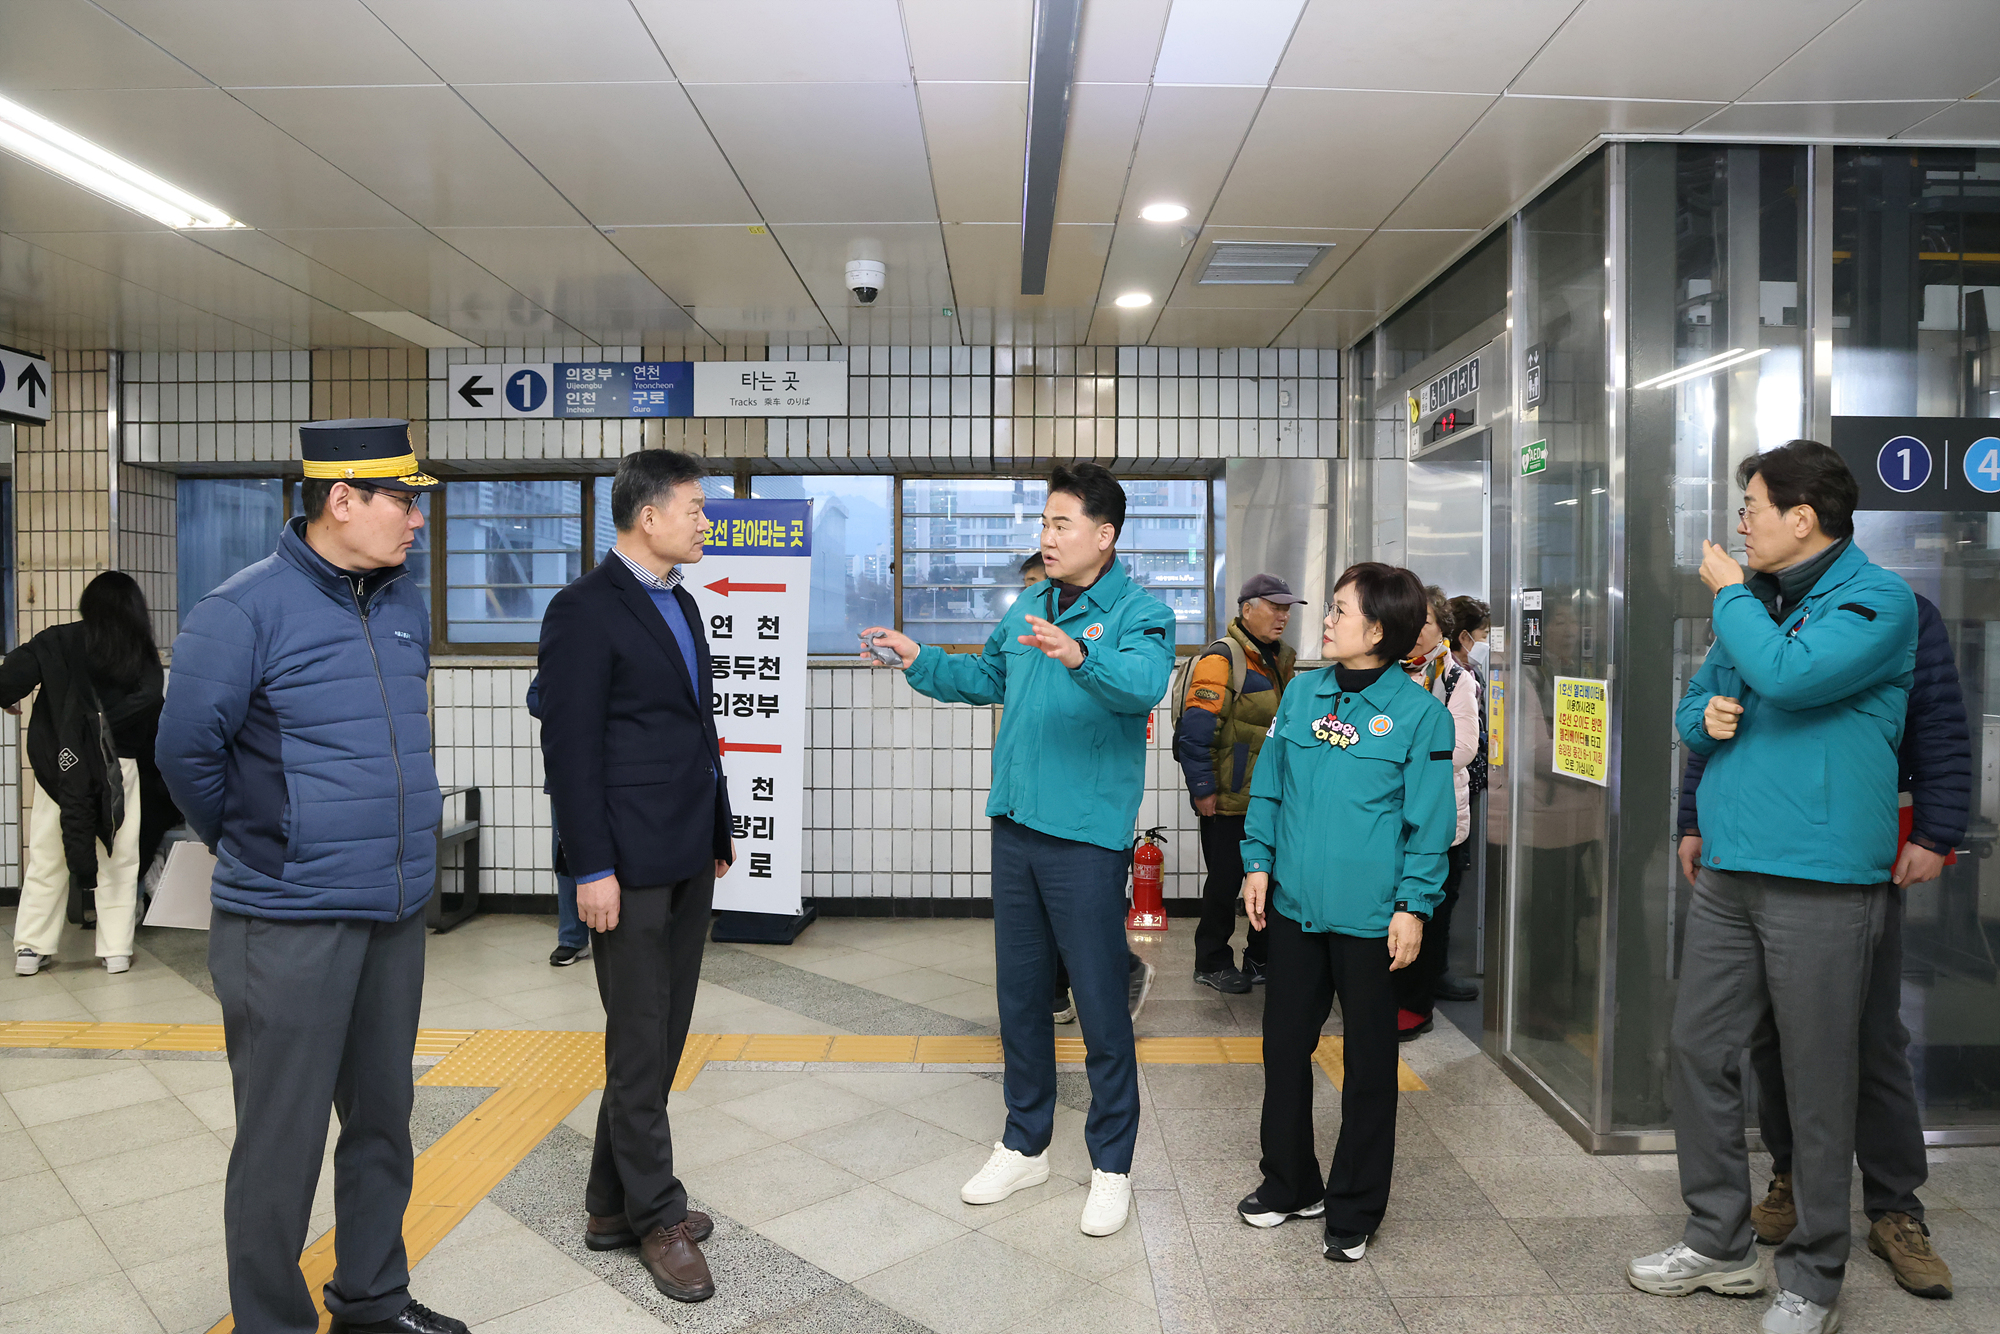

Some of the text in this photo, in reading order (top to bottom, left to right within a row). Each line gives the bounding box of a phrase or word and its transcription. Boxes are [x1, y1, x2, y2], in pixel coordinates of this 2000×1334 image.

[566, 365, 660, 381] 의정부 연천
[741, 371, 800, 391] 타는 곳
[516, 374, 532, 407] 1
[566, 382, 674, 390] Uijeongbu Yeoncheon
[566, 391, 665, 406] 인천 구로
[729, 398, 758, 406] Tracks
[786, 397, 811, 406] のりば
[1530, 448, 1541, 462] AED
[1896, 448, 1910, 481] 1
[1977, 448, 2000, 481] 4
[703, 519, 804, 548] 호선 갈아타는 곳
[711, 655, 780, 680] 동두천
[1559, 683, 1572, 697] 1호선
[713, 693, 780, 718] 의정부
[1566, 700, 1596, 714] 이용하시려면
[1320, 716, 1355, 737] 시의원
[1559, 712, 1602, 732] 4호선 오이도 방면
[1591, 736, 1600, 748] 타고
[1565, 758, 1595, 776] 으로 가십시오
[732, 815, 774, 840] 량리
